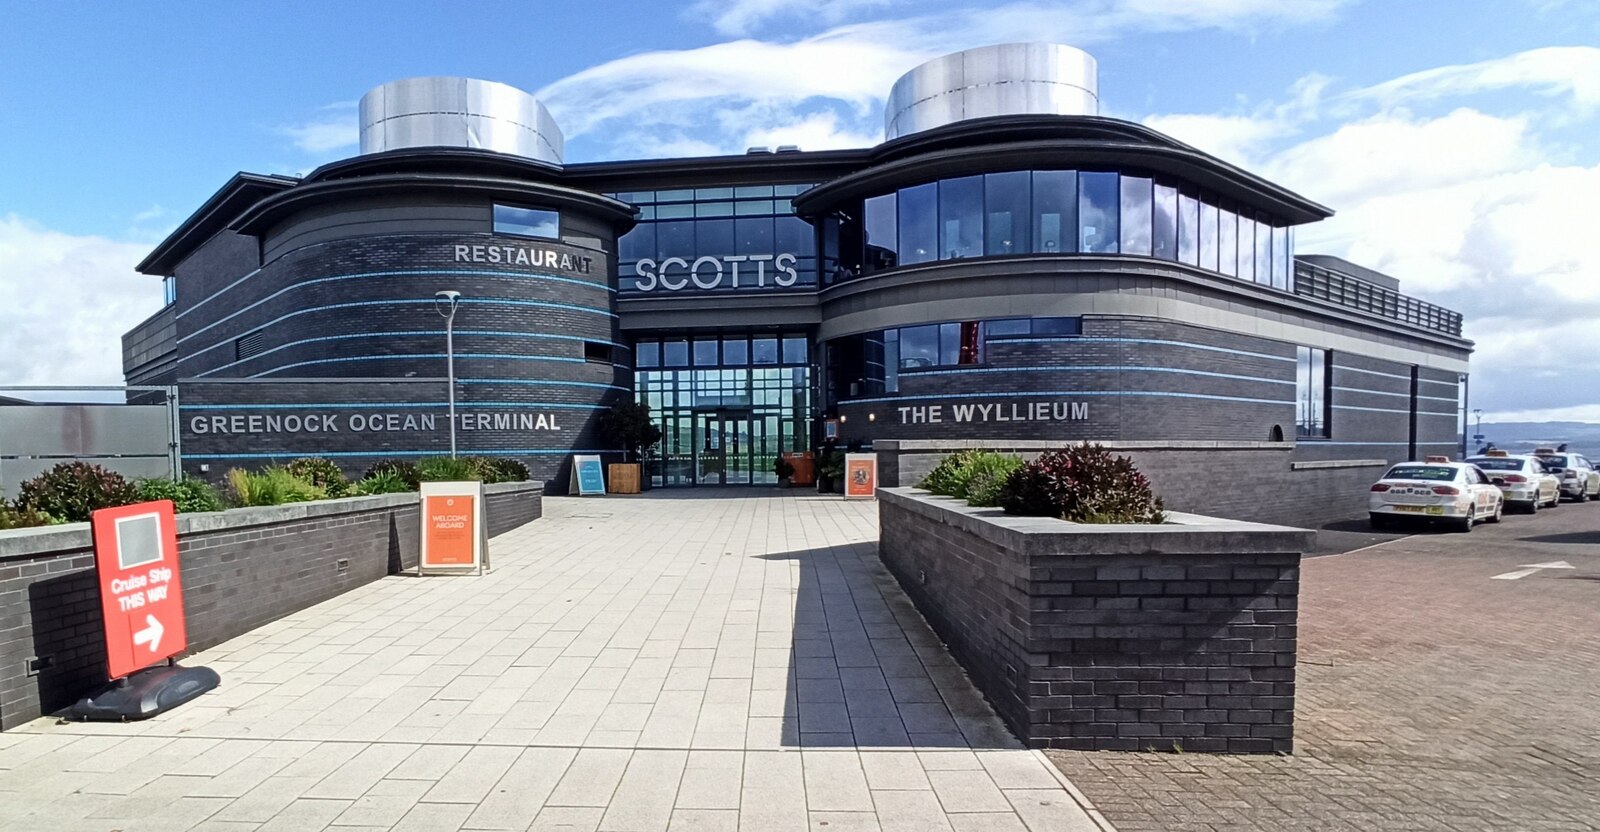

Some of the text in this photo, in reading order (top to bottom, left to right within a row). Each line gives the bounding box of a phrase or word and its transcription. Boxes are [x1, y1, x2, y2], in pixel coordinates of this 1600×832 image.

[454, 244, 592, 274] RESTAURANT
[635, 252, 797, 292] SCOTTS
[190, 414, 338, 435] GREENOCK
[349, 413, 435, 432] OCEAN
[898, 402, 1089, 424] THE WYLLIEUM
[111, 567, 172, 594] Cruise Ship
[118, 584, 168, 612] THIS WAY
